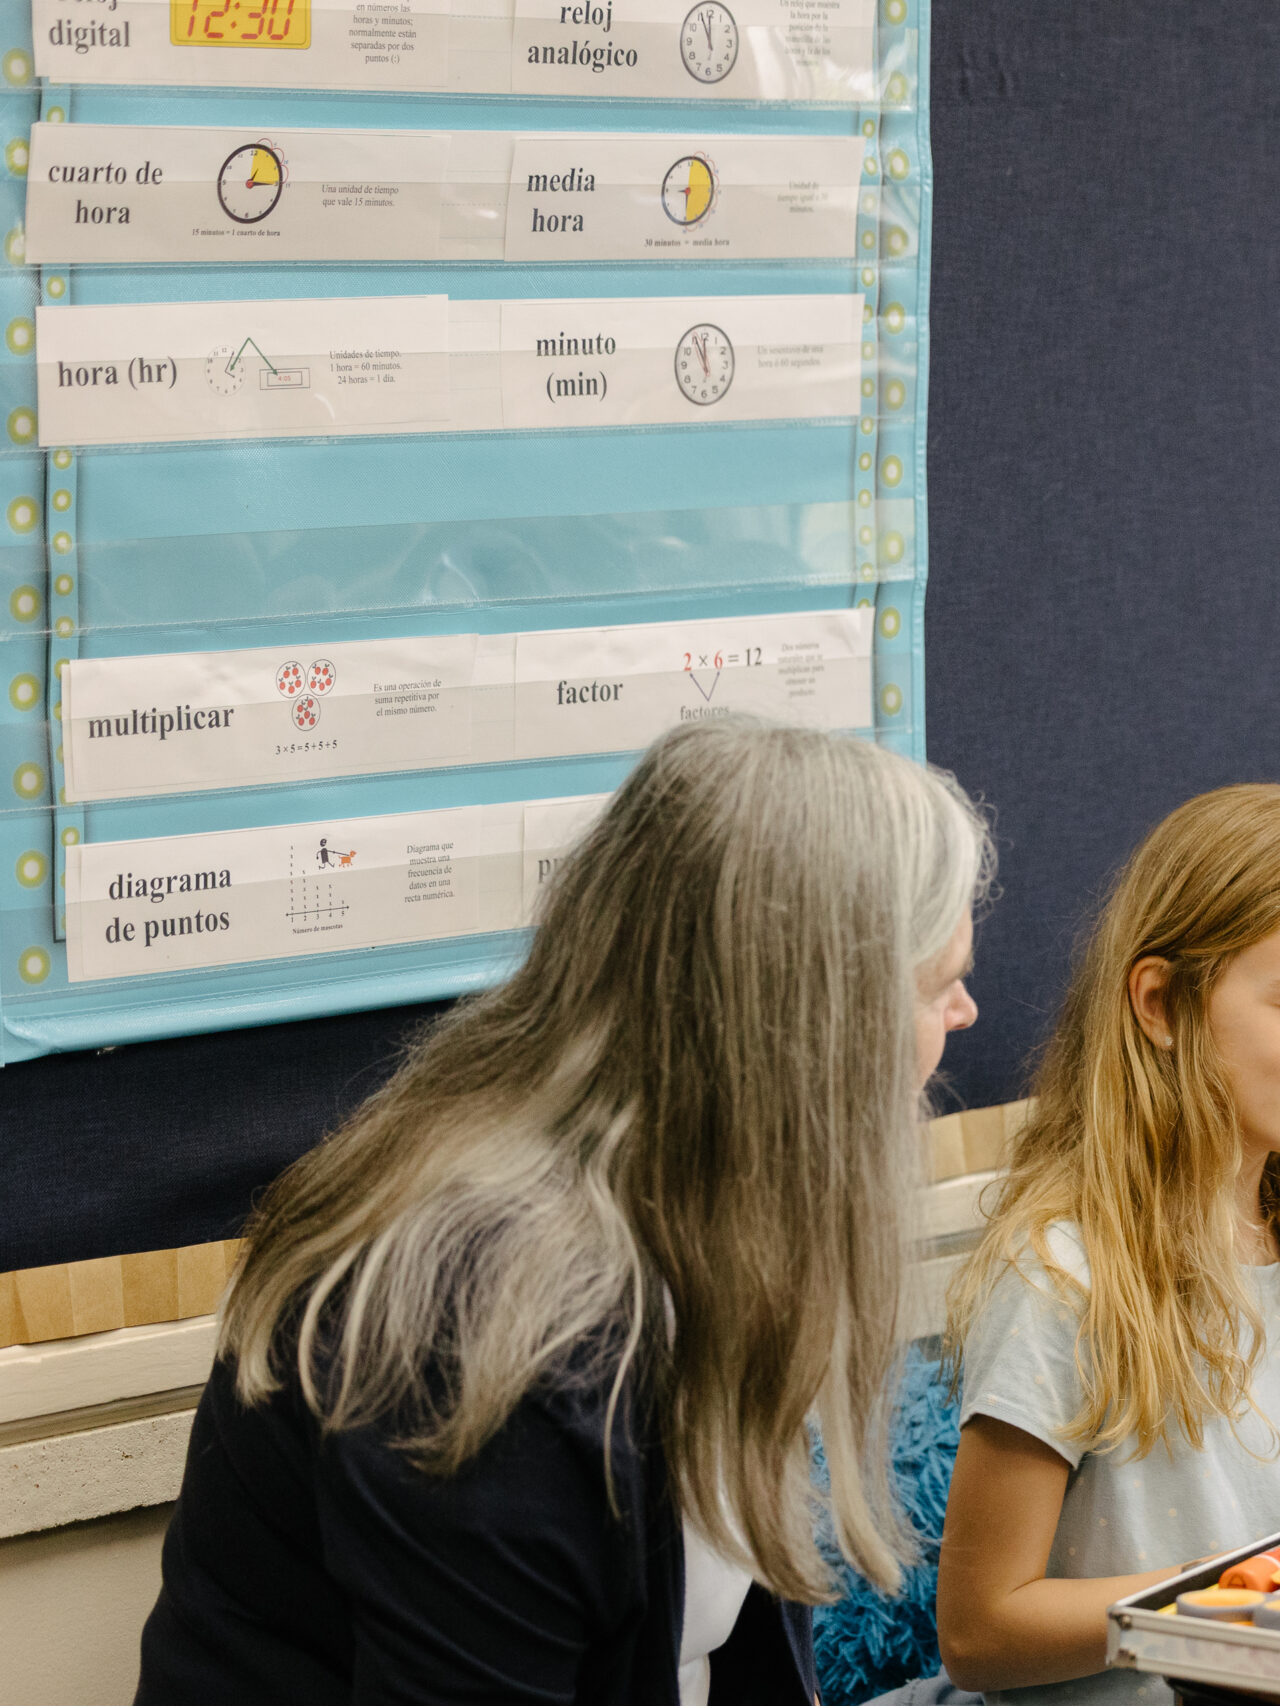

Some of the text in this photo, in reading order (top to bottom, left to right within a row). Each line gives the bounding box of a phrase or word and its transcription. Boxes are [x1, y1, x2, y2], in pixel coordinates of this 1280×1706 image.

[187, 0, 295, 40] 12:30
[560, 0, 612, 32] reloj
[49, 19, 130, 54] digital
[527, 40, 638, 73] analógico
[48, 160, 163, 186] cuarto de
[527, 168, 595, 193] media
[321, 184, 399, 196] Una unidad de tiempo
[322, 199, 336, 208] que
[337, 197, 353, 206] vale
[355, 197, 363, 206] 15
[75, 199, 131, 225] hora
[531, 207, 584, 233] hora
[329, 350, 363, 360] Unidades
[364, 349, 374, 358] de
[536, 331, 617, 357] minuto
[58, 356, 178, 390] hora (hr)
[336, 363, 353, 372] hora
[361, 362, 371, 371] 60
[337, 375, 347, 385] 24
[348, 375, 368, 384] horas
[546, 370, 608, 404] (min)
[683, 652, 692, 672] 2
[714, 649, 723, 670] 6
[728, 654, 739, 663] =
[745, 647, 762, 666] 12
[373, 678, 442, 692] Es una operación de
[556, 678, 624, 706] factor
[374, 692, 440, 705] suma repetitiva por
[88, 703, 235, 742] multiplicar
[376, 708, 383, 717] el
[384, 707, 408, 716] mismo
[680, 705, 729, 721] factores
[275, 745, 281, 755] 3
[290, 743, 296, 754] 5
[304, 742, 310, 752] 5
[318, 740, 323, 751] 5
[332, 739, 338, 749] 5
[407, 842, 454, 855] Diagrama que
[107, 864, 232, 904] diagrama
[407, 865, 452, 879] frecuencia de
[408, 881, 427, 890] datos
[428, 880, 437, 888] en
[404, 894, 421, 903] recta
[105, 906, 231, 947] de puntos
